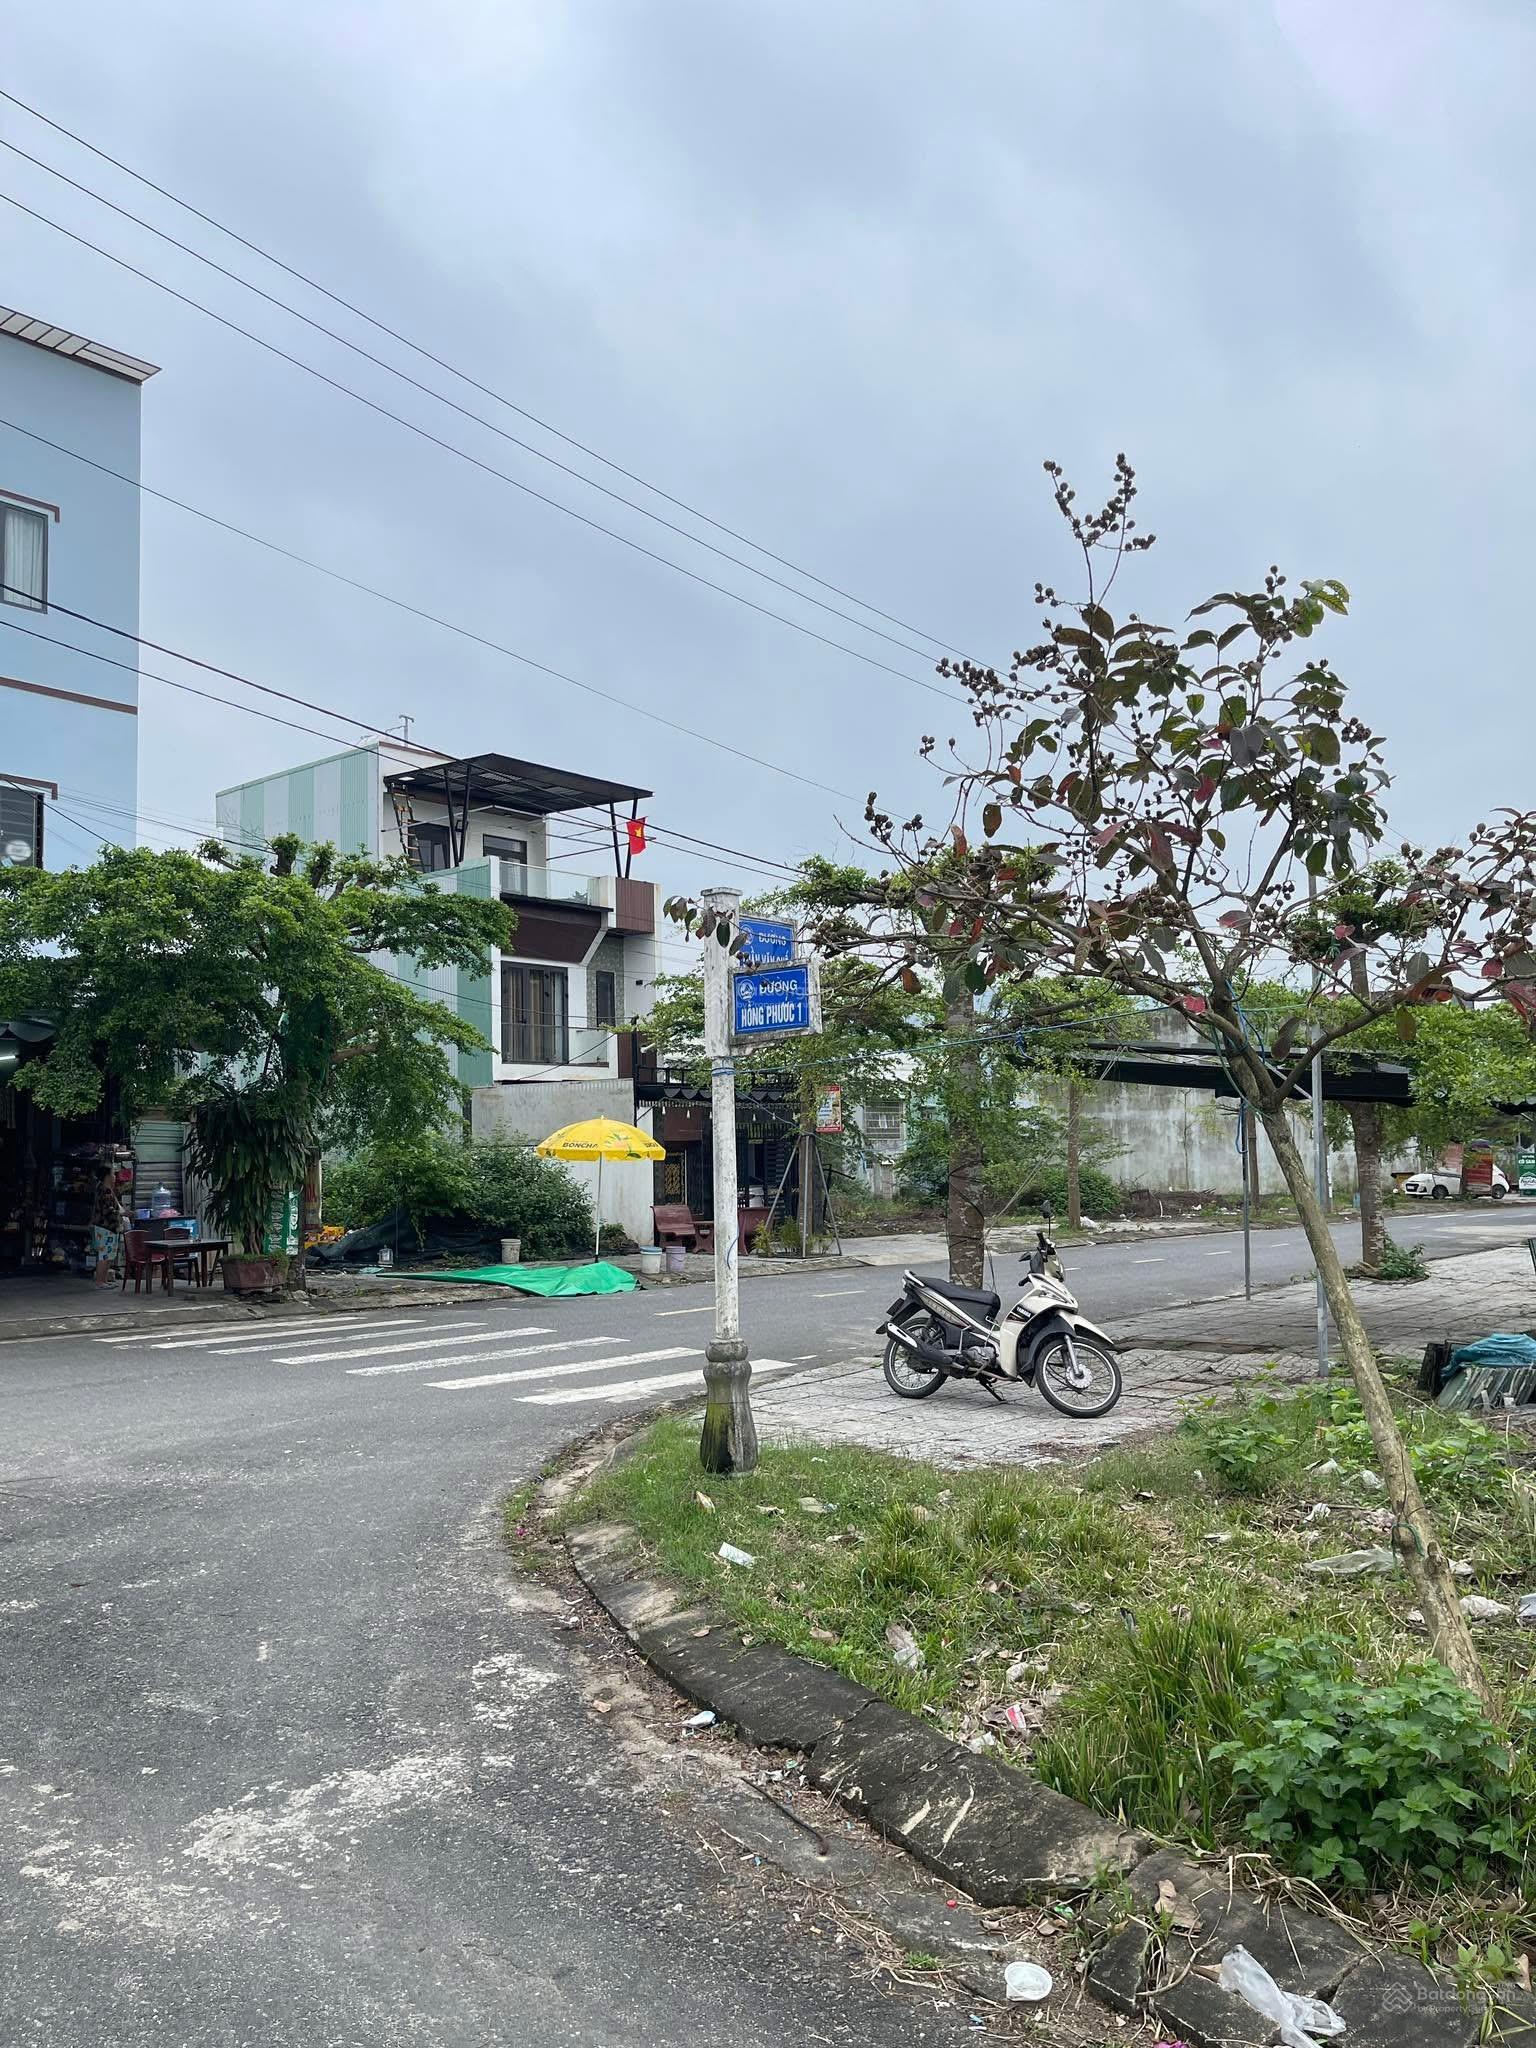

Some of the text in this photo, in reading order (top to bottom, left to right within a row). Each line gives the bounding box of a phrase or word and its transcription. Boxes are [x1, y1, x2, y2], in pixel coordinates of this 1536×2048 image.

[758, 930, 787, 946] ĐƯỜNG
[759, 977, 798, 995] ĐƯỜNG
[741, 997, 802, 1028] HỒNG PHƯỚC 1
